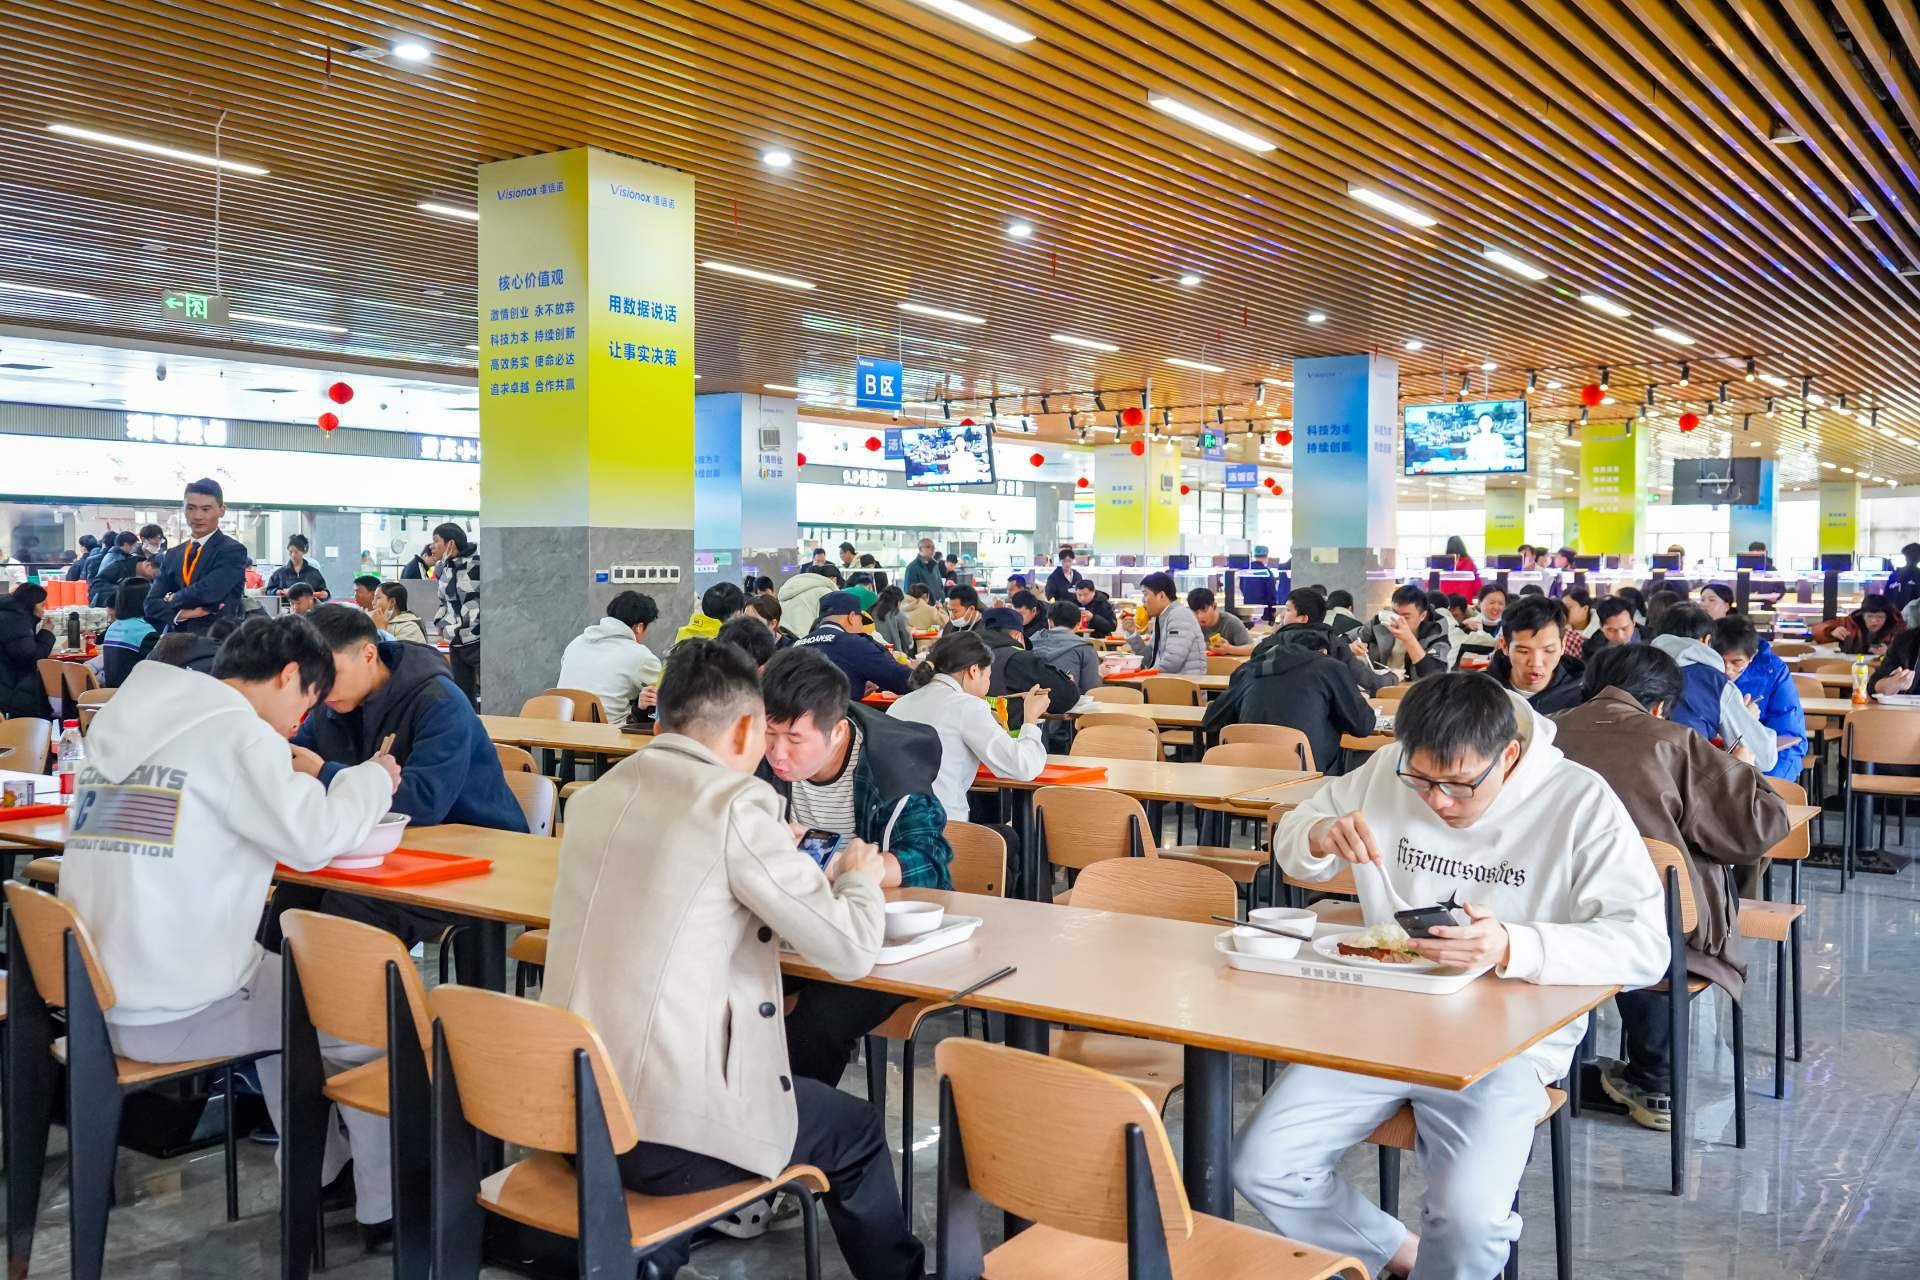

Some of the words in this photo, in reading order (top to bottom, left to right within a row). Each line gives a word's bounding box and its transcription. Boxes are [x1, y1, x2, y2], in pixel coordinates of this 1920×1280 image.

[497, 187, 537, 200] Visionox
[610, 183, 651, 203] Visionox
[499, 269, 564, 291] 核心价值观
[490, 305, 530, 321] 激情创业
[535, 302, 576, 318] 永不放弃
[609, 294, 677, 323] 用数据说话
[490, 331, 530, 346] 科技为本
[535, 327, 576, 342] 持续创新
[490, 356, 530, 371] 高效务实
[535, 353, 576, 368] 使命必达
[609, 340, 677, 367] 让事实决策
[490, 382, 530, 396] 追求卓越
[535, 378, 576, 393] 合作共赢
[865, 373, 895, 397] B区
